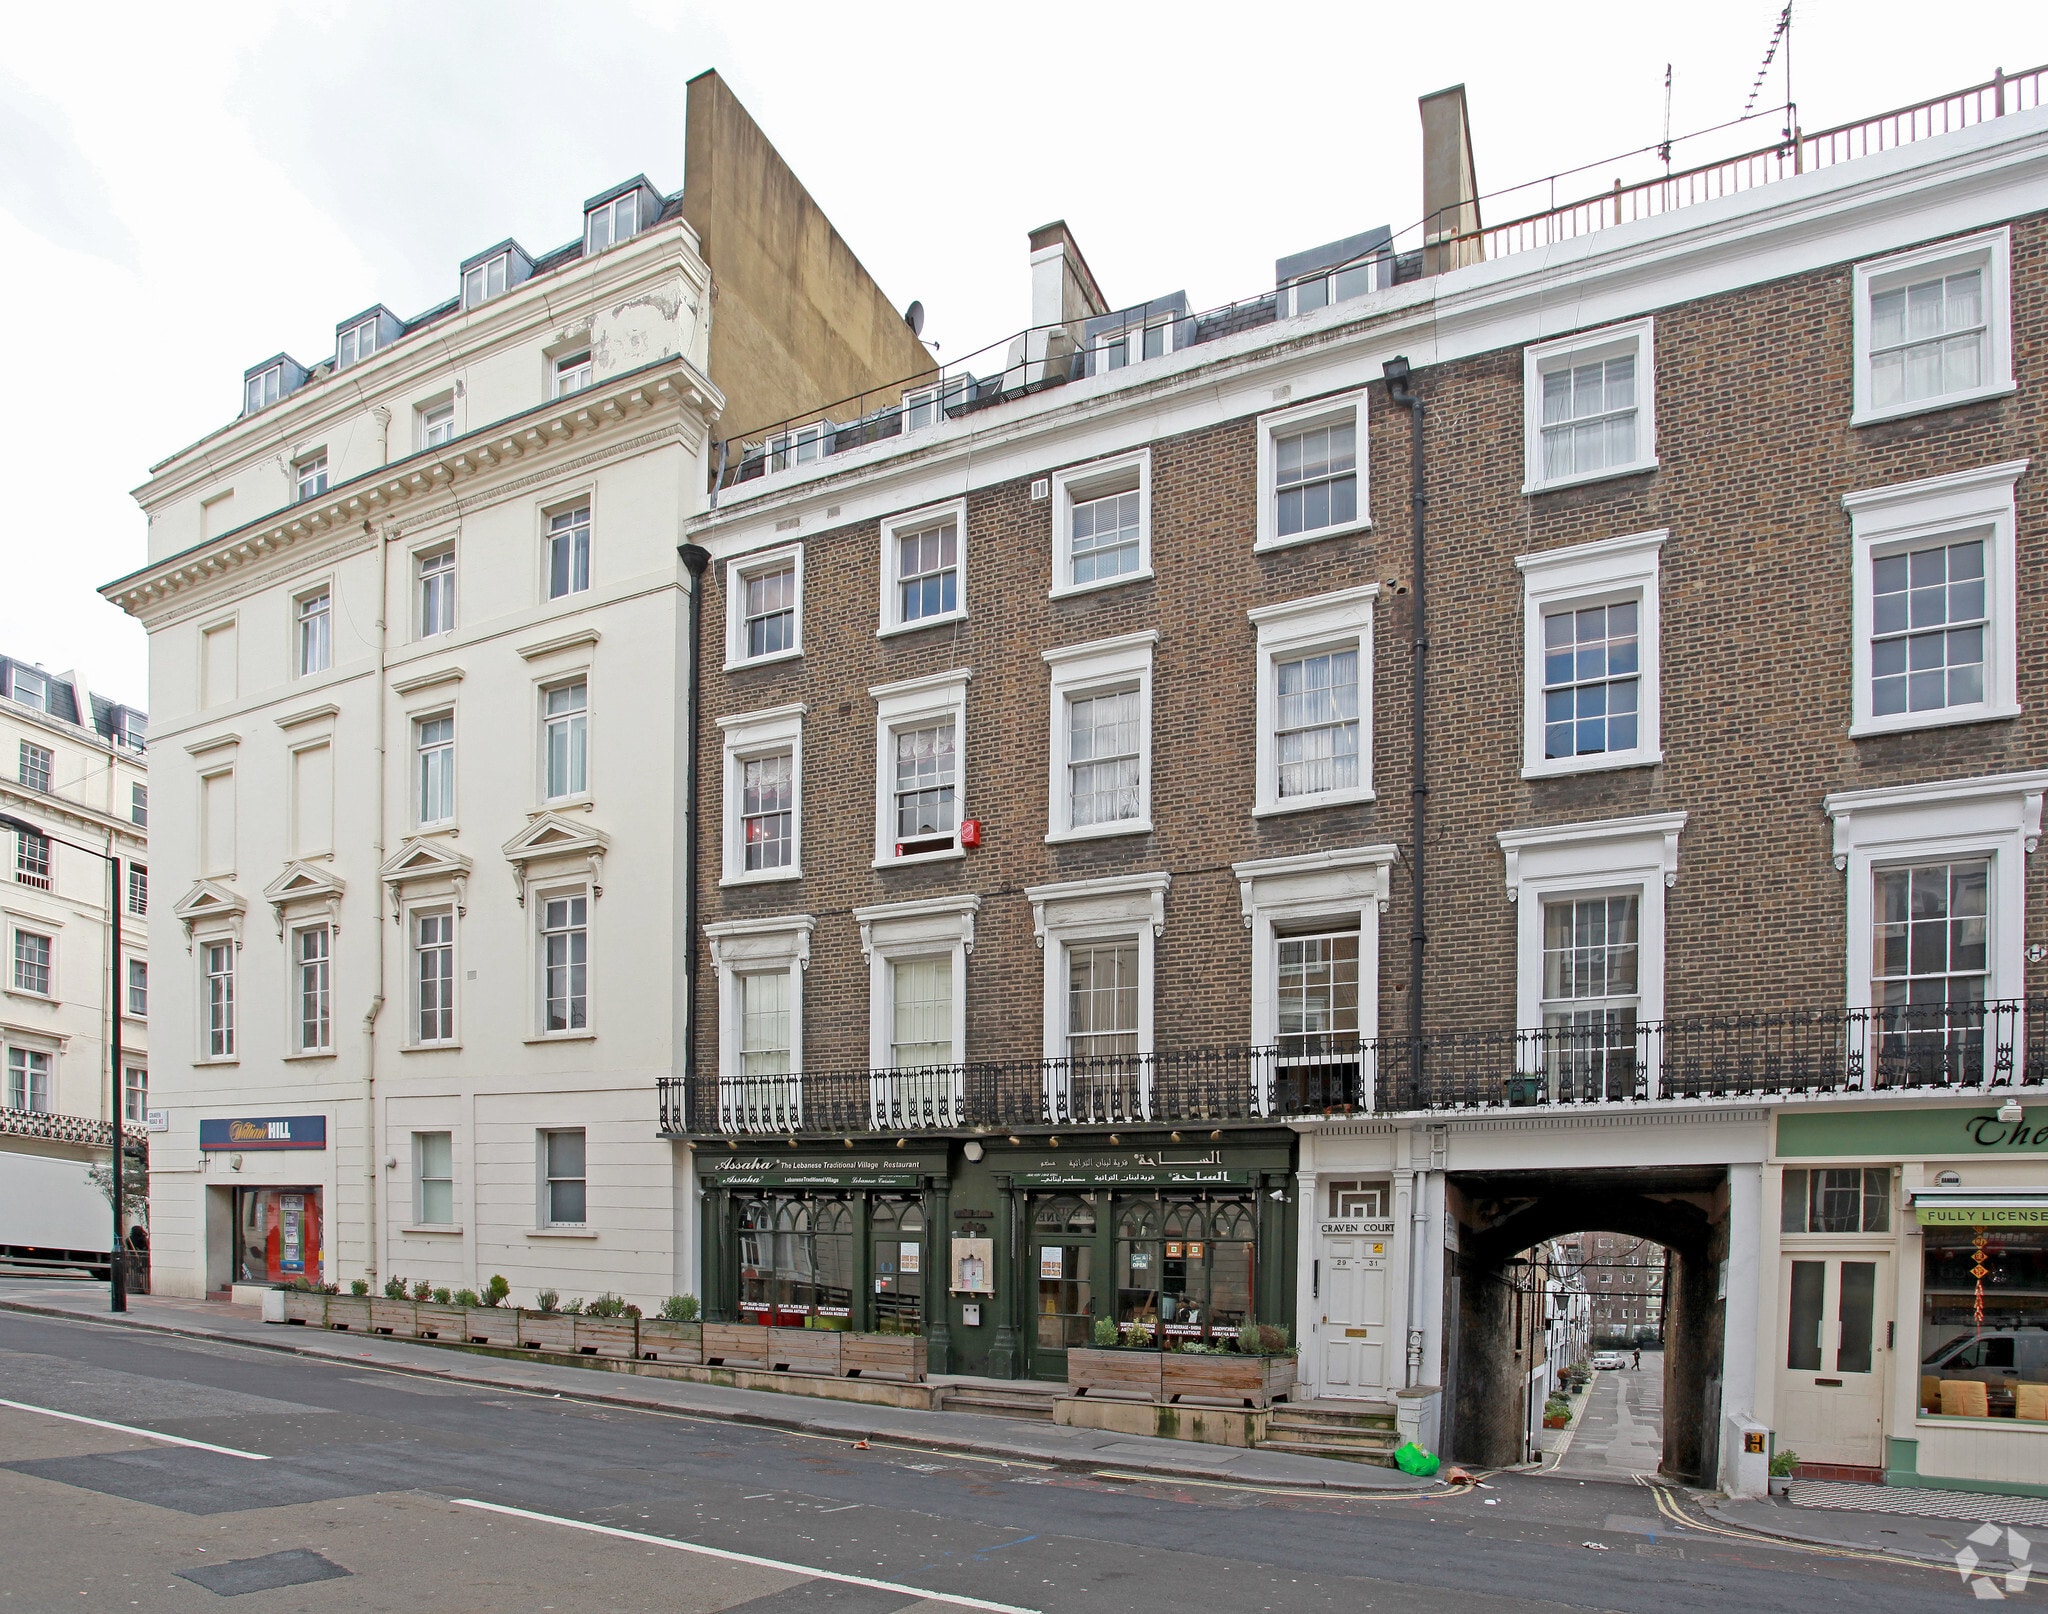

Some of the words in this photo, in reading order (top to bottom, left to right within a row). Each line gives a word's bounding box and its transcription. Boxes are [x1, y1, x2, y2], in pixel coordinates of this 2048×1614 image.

[229, 1120, 268, 1141] William
[268, 1121, 291, 1139] HILL
[1966, 1112, 2048, 1146] The
[715, 1157, 774, 1170] Assaha
[824, 1161, 856, 1169] Traditional
[857, 1161, 879, 1170] Village
[722, 1175, 761, 1183] Assaha
[1928, 1211, 1976, 1221] FULLY
[1321, 1224, 1358, 1232] CRAVEN
[1363, 1223, 1395, 1232] COURT
